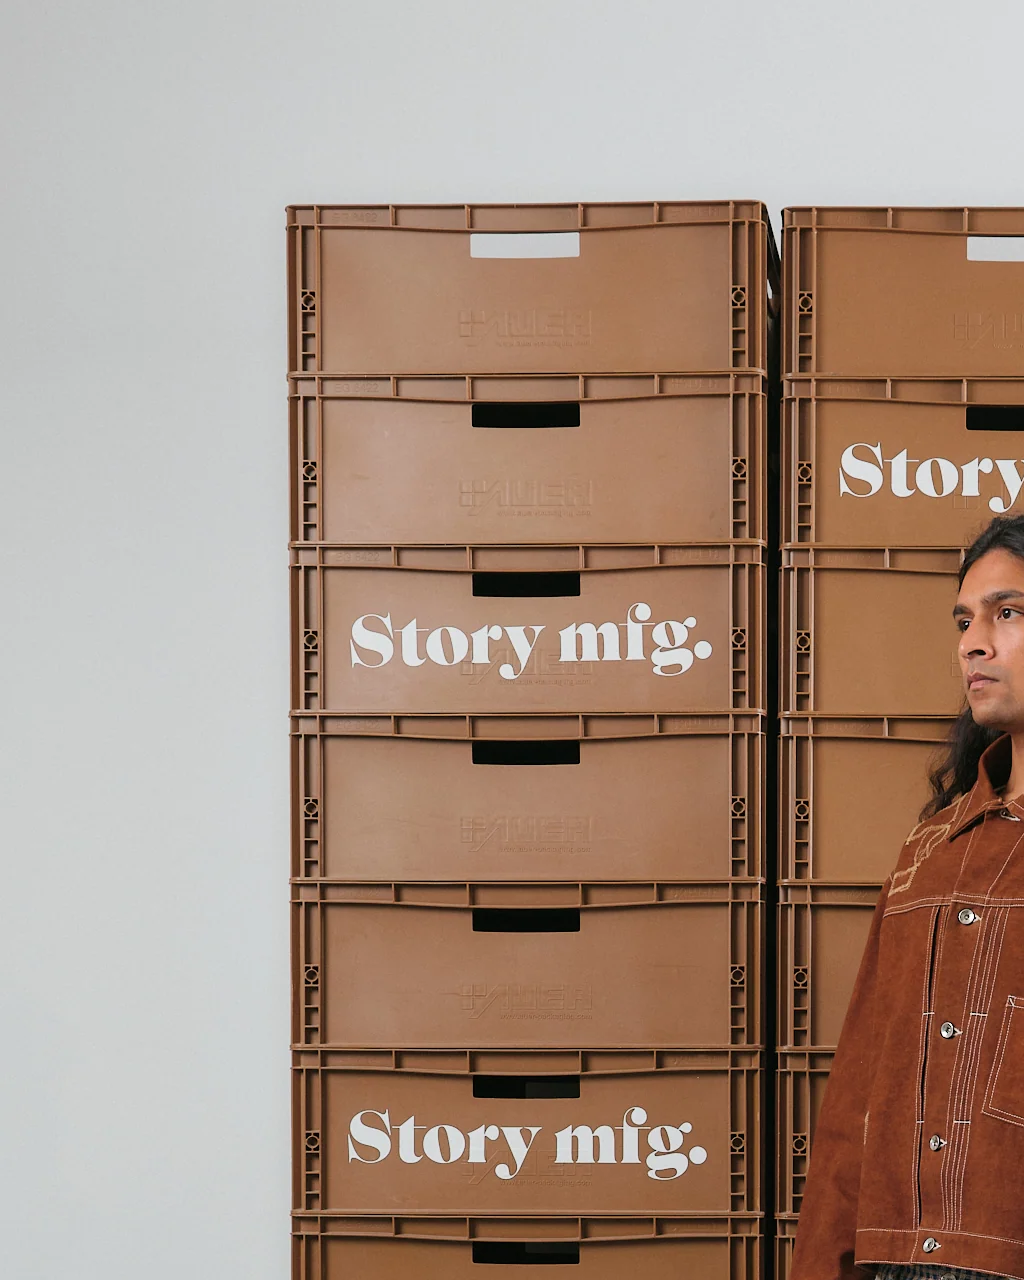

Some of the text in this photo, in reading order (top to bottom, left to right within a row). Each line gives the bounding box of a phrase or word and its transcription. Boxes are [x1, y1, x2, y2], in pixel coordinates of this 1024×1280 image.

[349, 602, 713, 680] Story mfg.
[347, 1106, 707, 1181] Story mfg.
